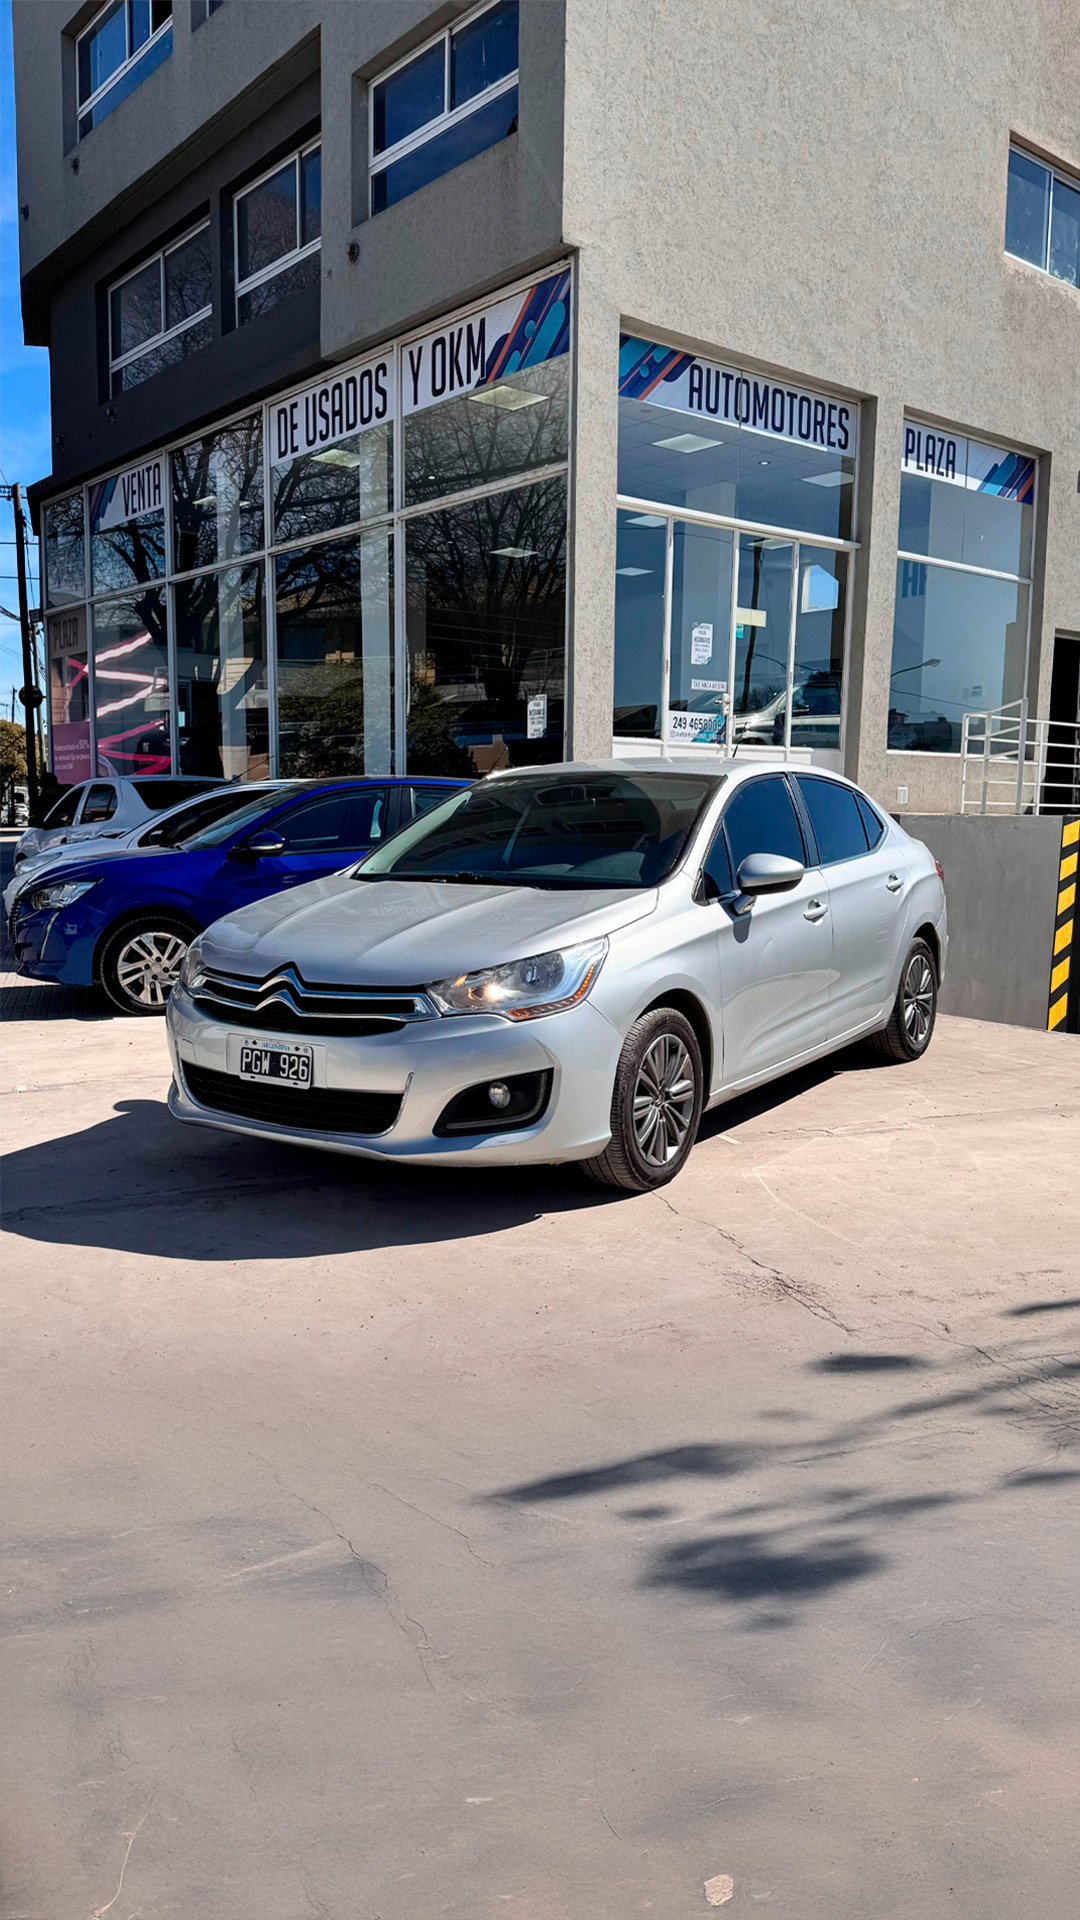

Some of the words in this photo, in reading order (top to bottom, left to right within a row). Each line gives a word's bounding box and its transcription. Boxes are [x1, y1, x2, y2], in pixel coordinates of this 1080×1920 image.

[122, 462, 161, 517] VENTA
[277, 401, 298, 459] DE
[305, 362, 387, 447] USADOS
[409, 345, 423, 406] Y
[688, 364, 849, 450] AUTOMOTORES
[904, 428, 957, 480] PLAZA
[53, 617, 78, 650] PLAZA
[673, 716, 688, 730] 249
[262, 1042, 290, 1051] ARGENTINA
[242, 1048, 270, 1074] PGW
[279, 1054, 309, 1080] 926
